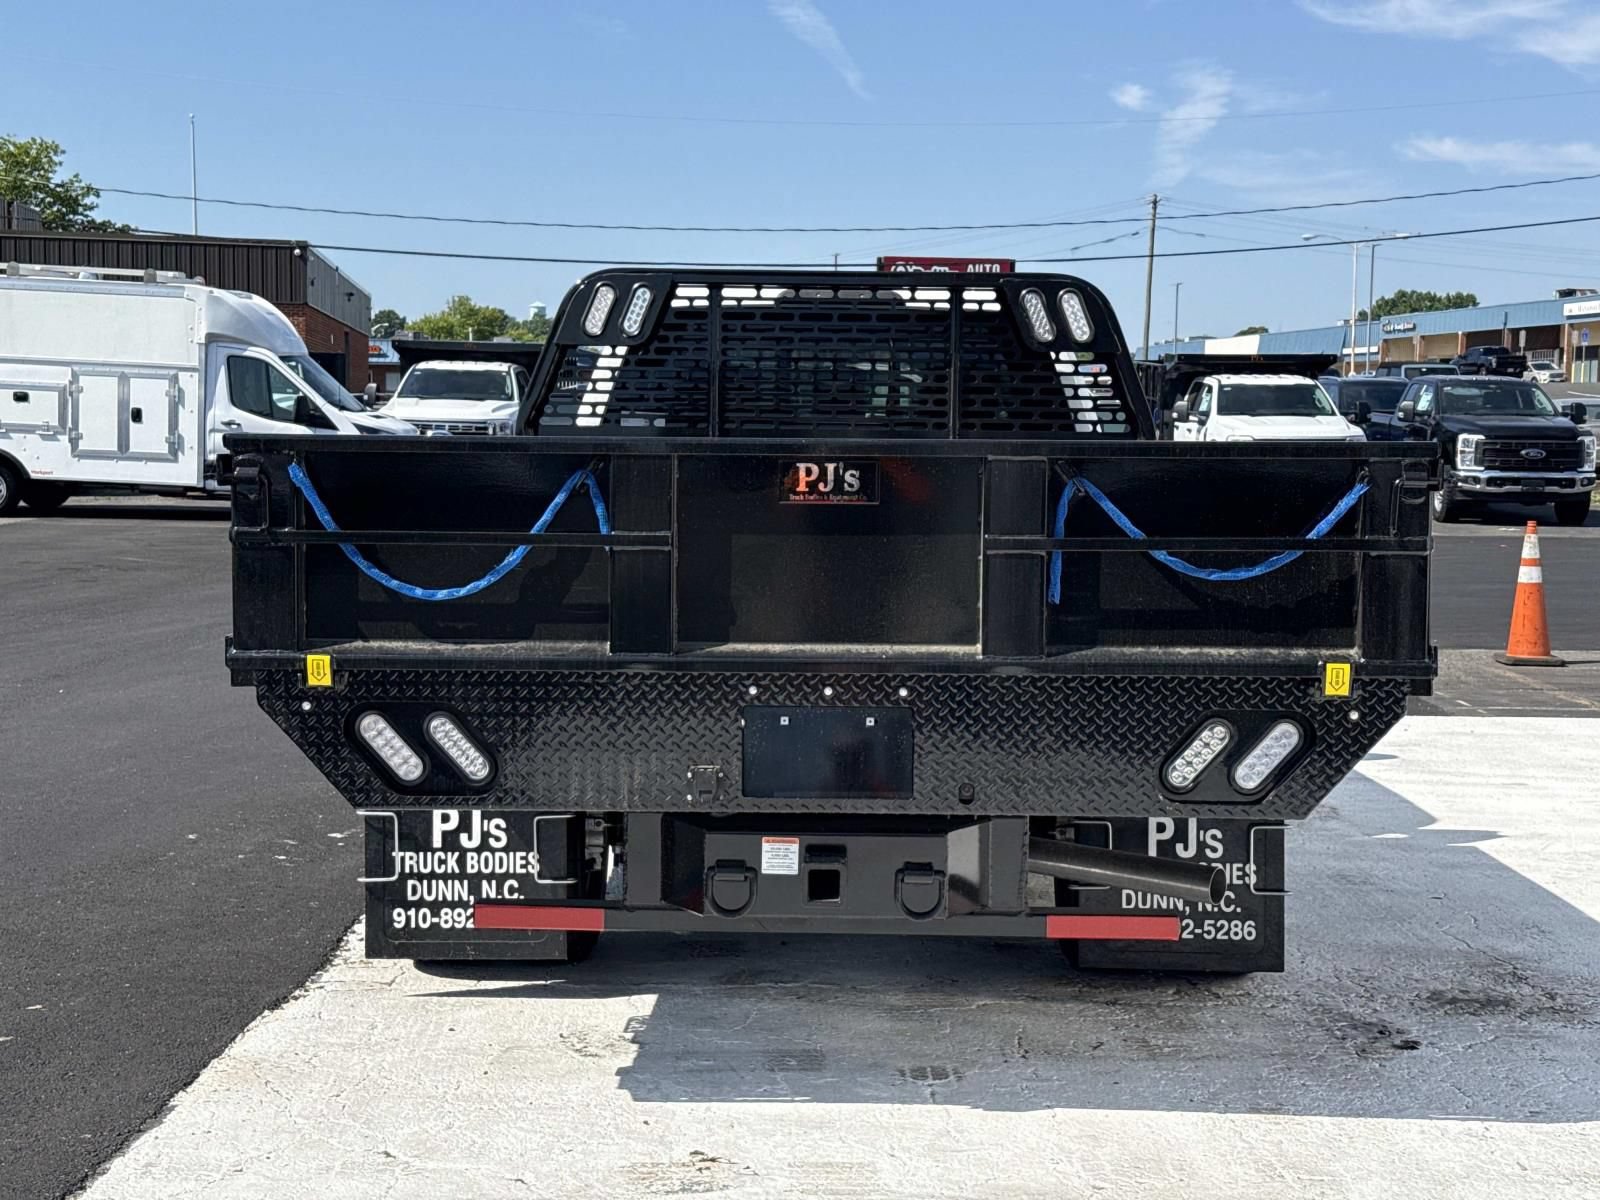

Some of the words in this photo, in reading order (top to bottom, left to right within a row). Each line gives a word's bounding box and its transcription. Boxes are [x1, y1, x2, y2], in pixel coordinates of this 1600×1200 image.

[795, 461, 861, 492] PJ's
[392, 852, 460, 874] TRUCK
[466, 852, 540, 874] BODIES
[407, 880, 474, 904] DUNN,
[481, 880, 525, 899] N.C.
[392, 908, 475, 929] 910-892
[1181, 918, 1257, 941] 2-5286
